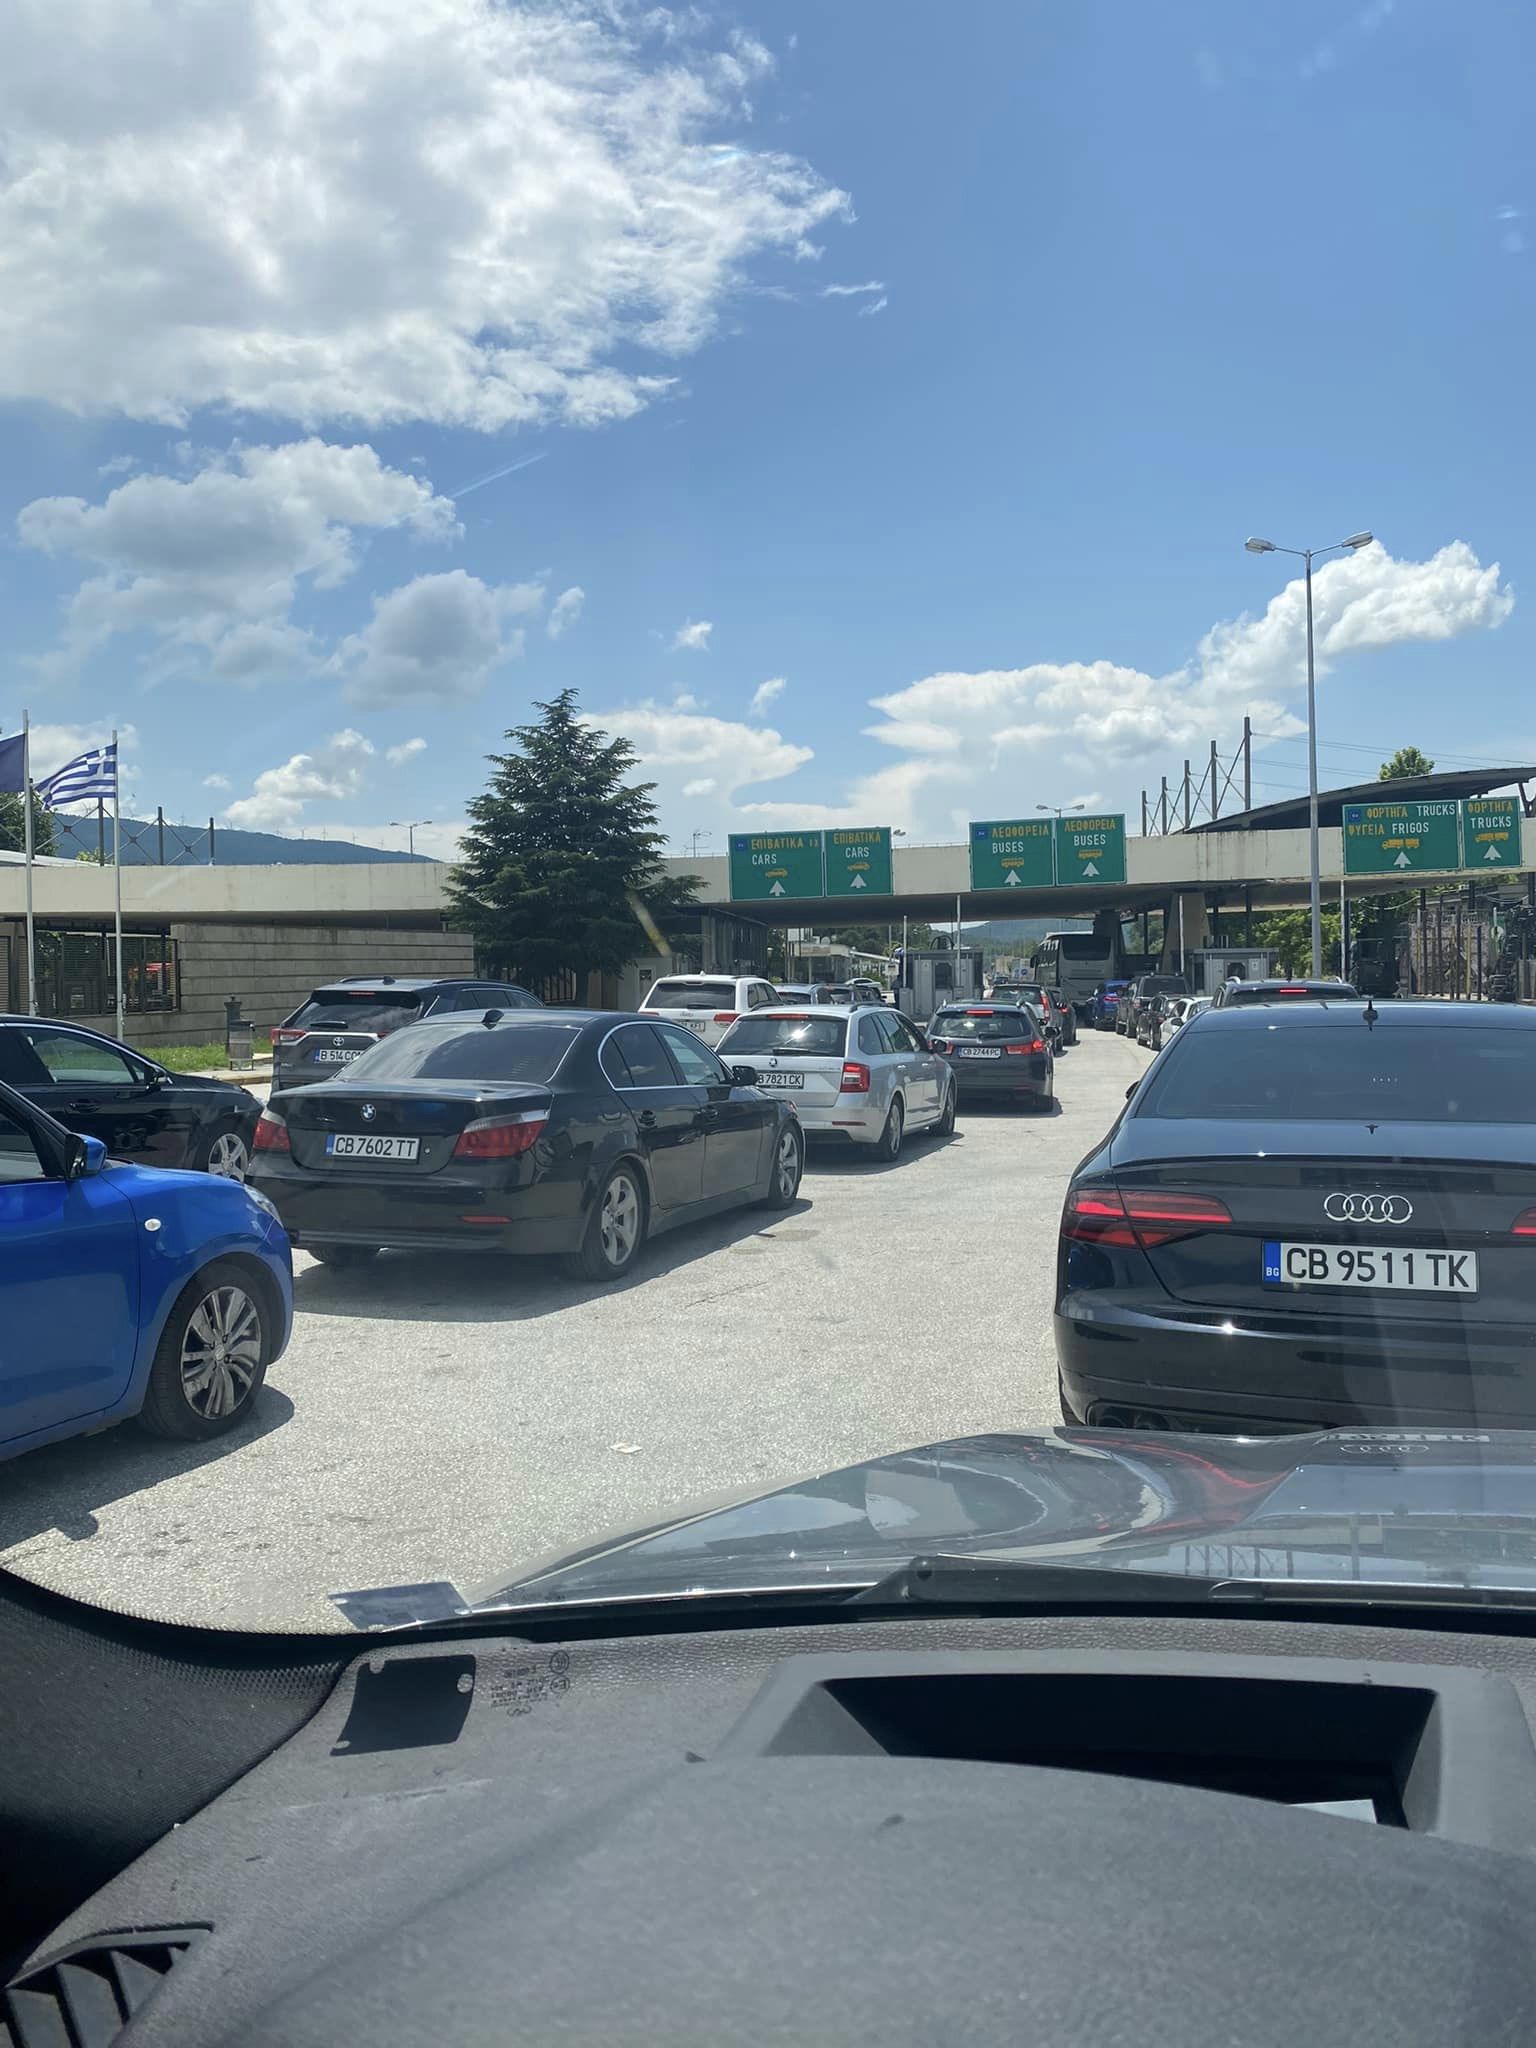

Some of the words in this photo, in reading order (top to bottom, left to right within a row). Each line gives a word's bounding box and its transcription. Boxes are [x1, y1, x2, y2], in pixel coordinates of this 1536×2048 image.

[1416, 804, 1456, 817] TRUCKS
[1391, 822, 1430, 835] FRIGOS
[1470, 816, 1512, 829] TRUCKS
[1073, 834, 1107, 846] BUSES
[845, 847, 870, 858] CARS
[992, 841, 1024, 854] BUSES
[752, 853, 777, 865] CARS
[320, 1050, 327, 1060] B
[330, 1050, 343, 1060] 514
[765, 1074, 787, 1085] 7821
[789, 1074, 801, 1085] CK
[335, 1137, 354, 1154] CB
[356, 1138, 393, 1156] 7602
[396, 1139, 417, 1157] TT
[1265, 1266, 1280, 1277] BG
[1286, 1247, 1329, 1280] CB
[1336, 1250, 1414, 1285] 9511
[1425, 1254, 1470, 1288] TK
